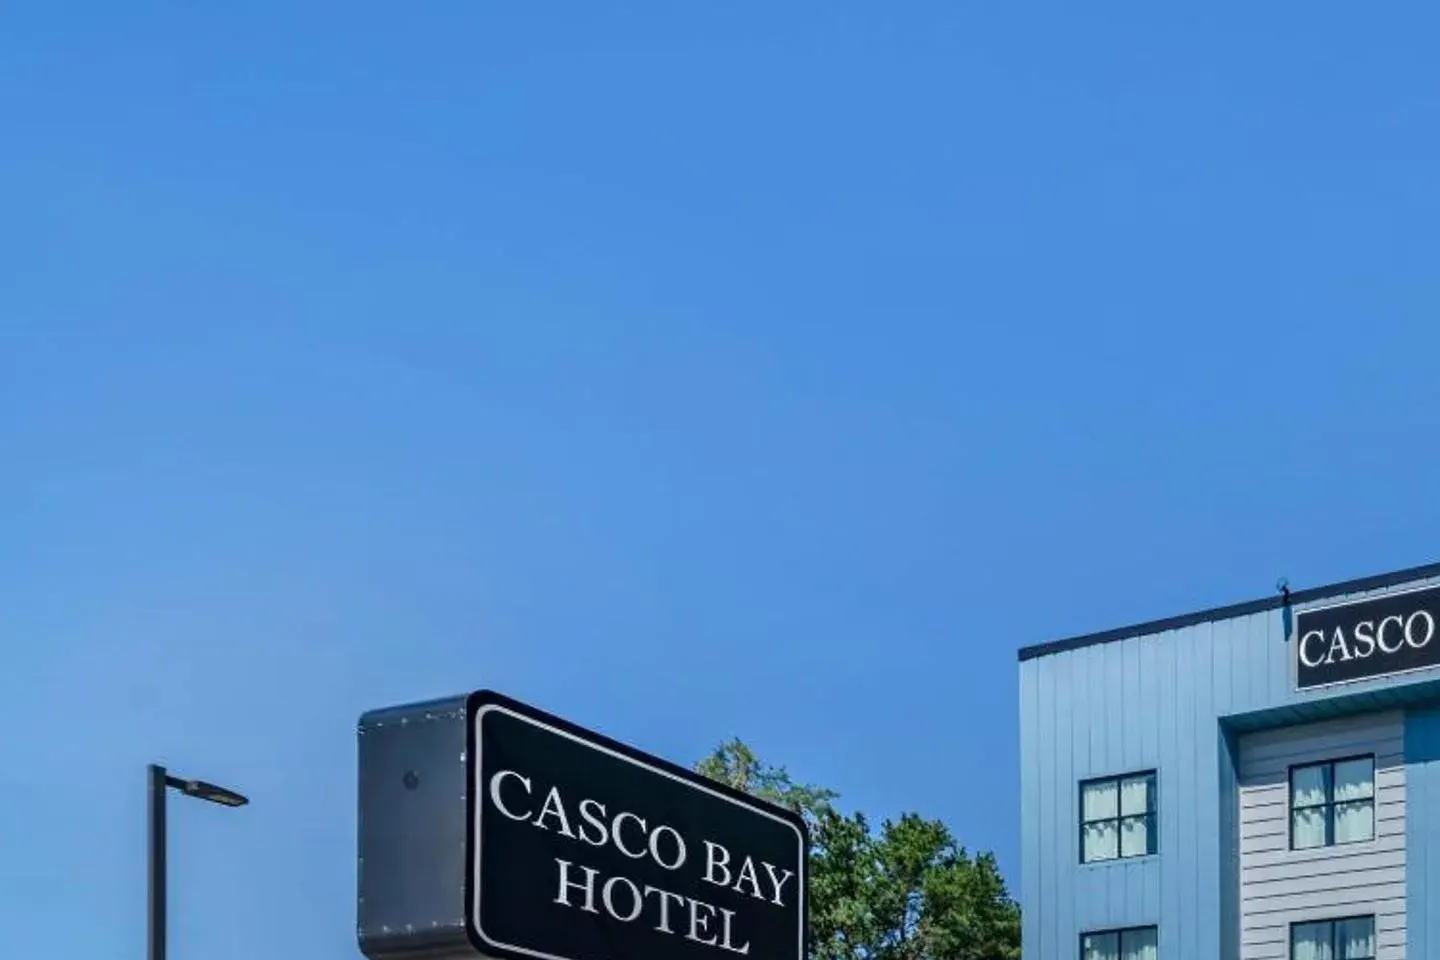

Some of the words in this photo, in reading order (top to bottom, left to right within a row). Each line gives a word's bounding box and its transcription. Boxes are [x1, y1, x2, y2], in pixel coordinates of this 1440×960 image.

[1299, 610, 1435, 668] CASCO
[490, 770, 687, 870] CASCO
[701, 839, 795, 907] BAY
[553, 858, 750, 955] HOTEL
